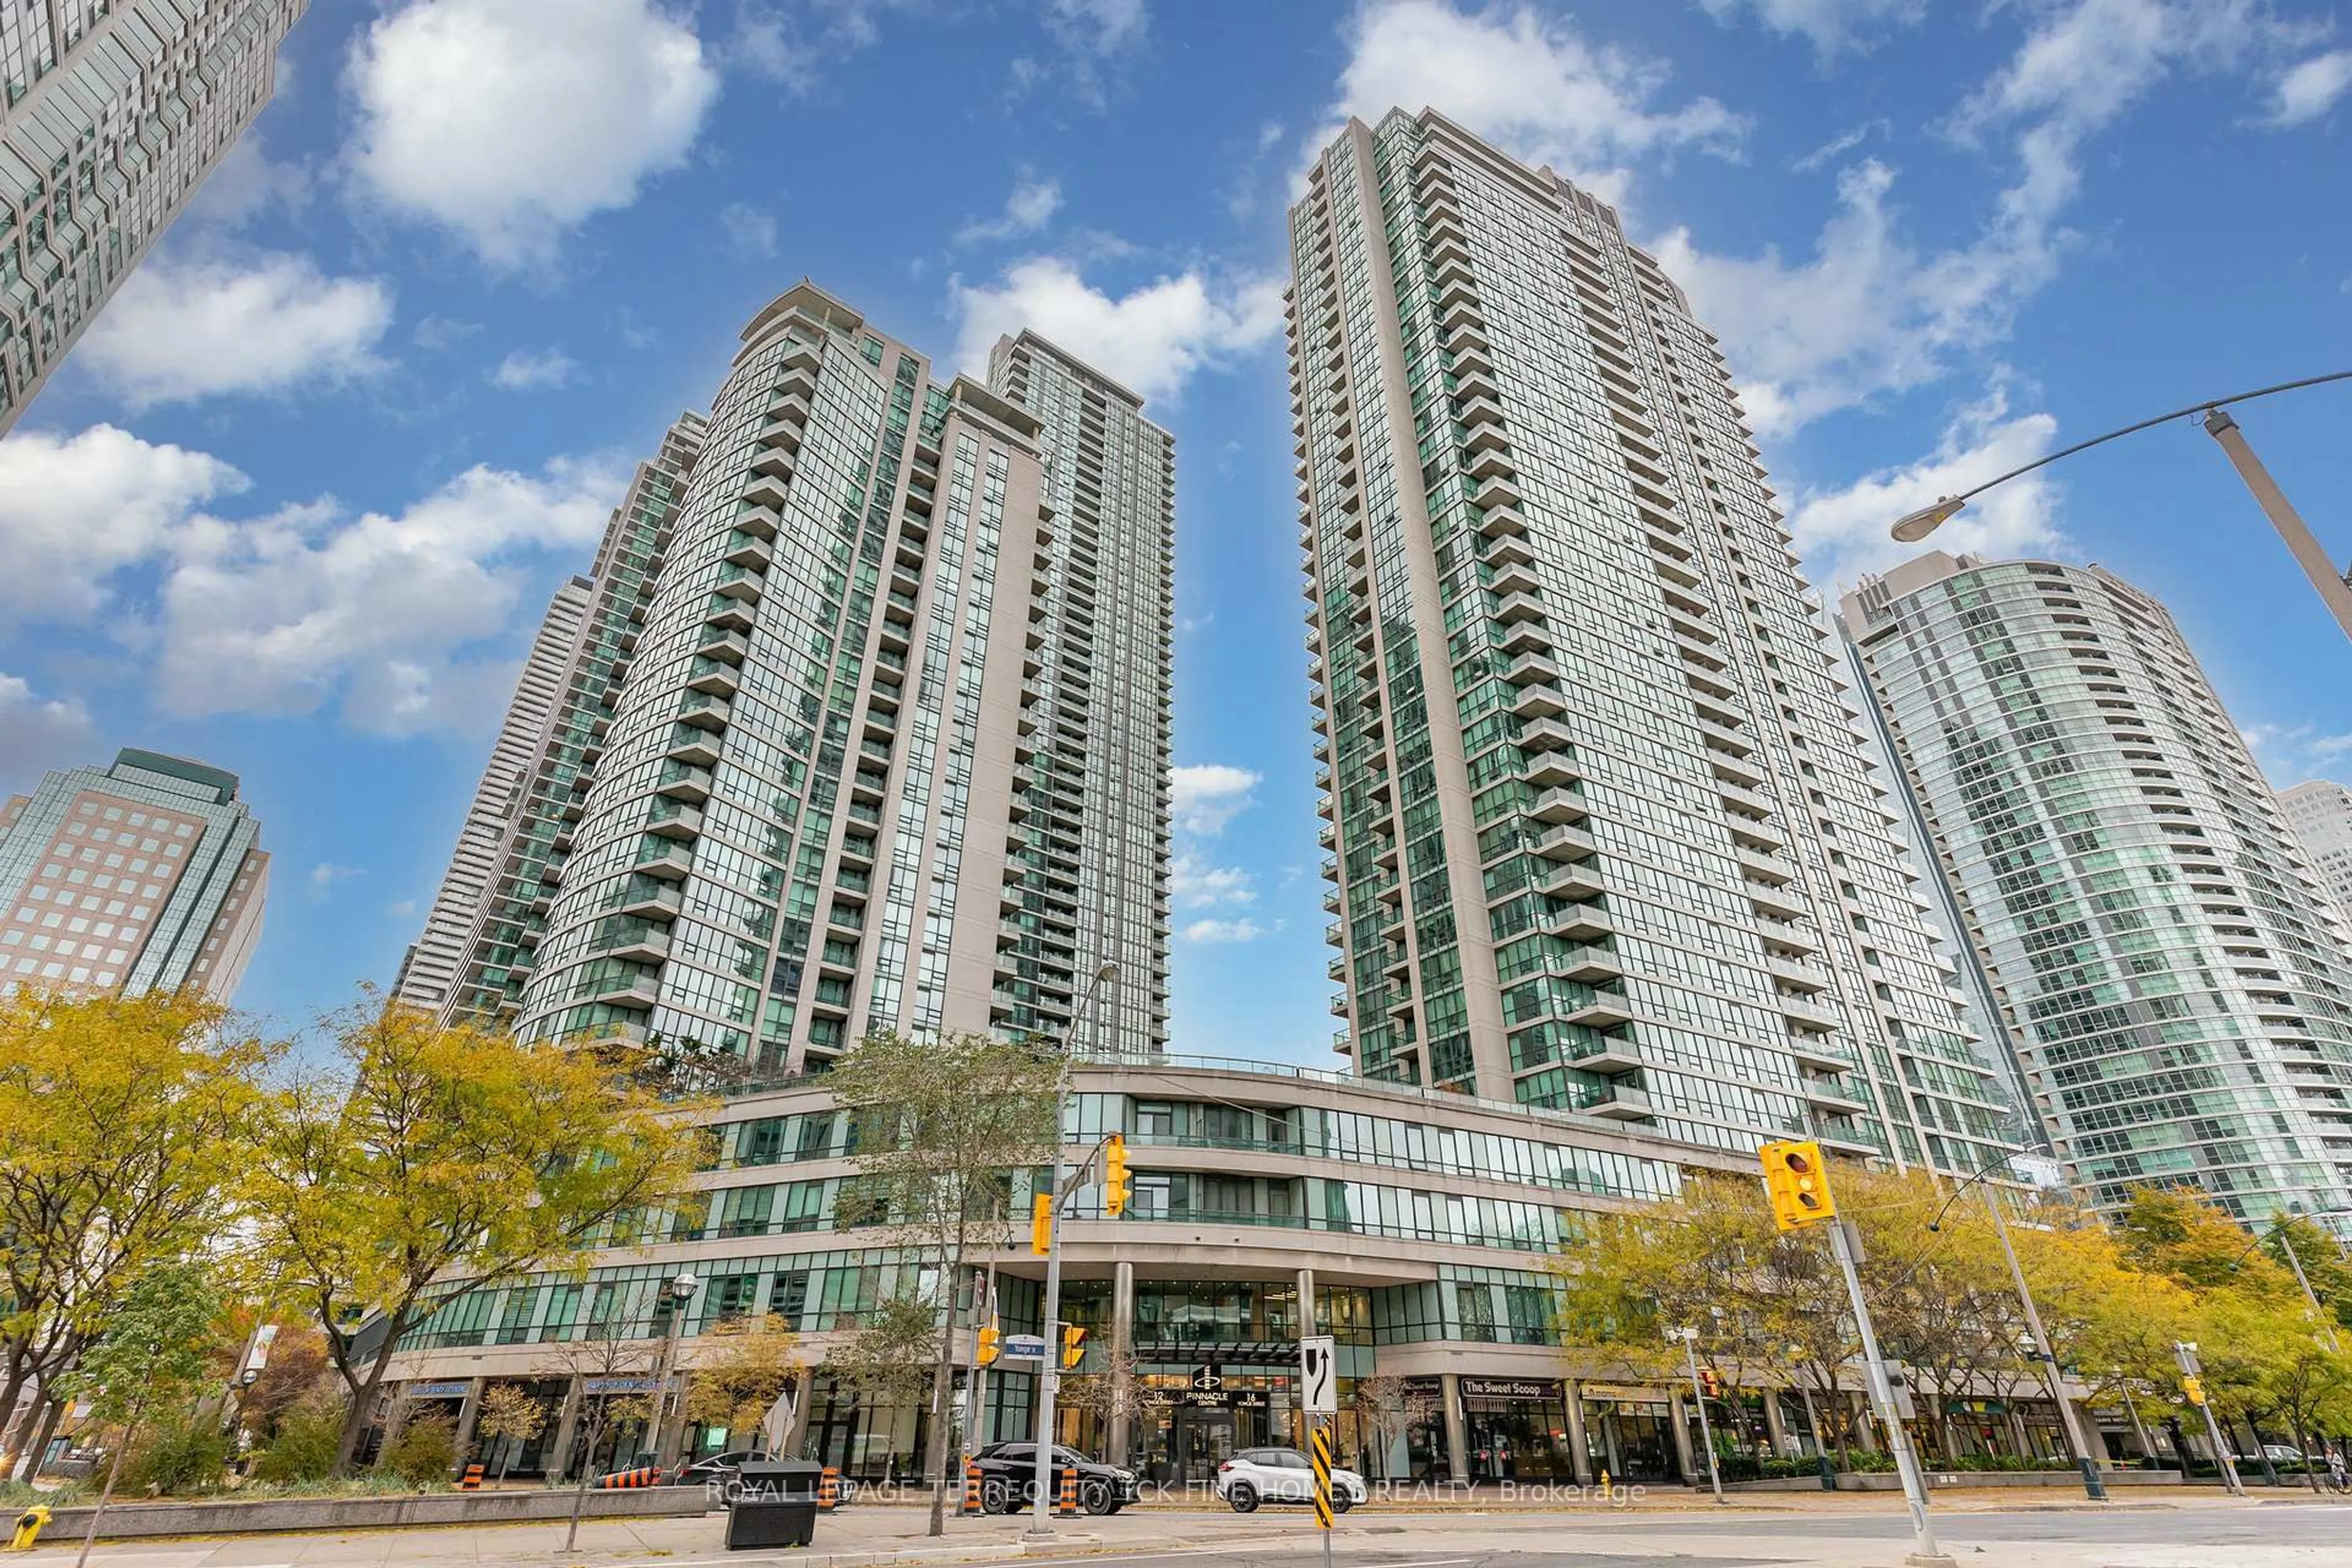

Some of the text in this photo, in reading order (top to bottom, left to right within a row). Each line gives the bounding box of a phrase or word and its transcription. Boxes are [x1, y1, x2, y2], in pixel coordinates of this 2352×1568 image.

[1465, 1381, 1540, 1396] The Sweet Scoop
[1154, 1392, 1164, 1400] 12
[1186, 1392, 1228, 1401] PINNACLE
[1246, 1393, 1256, 1402] 16
